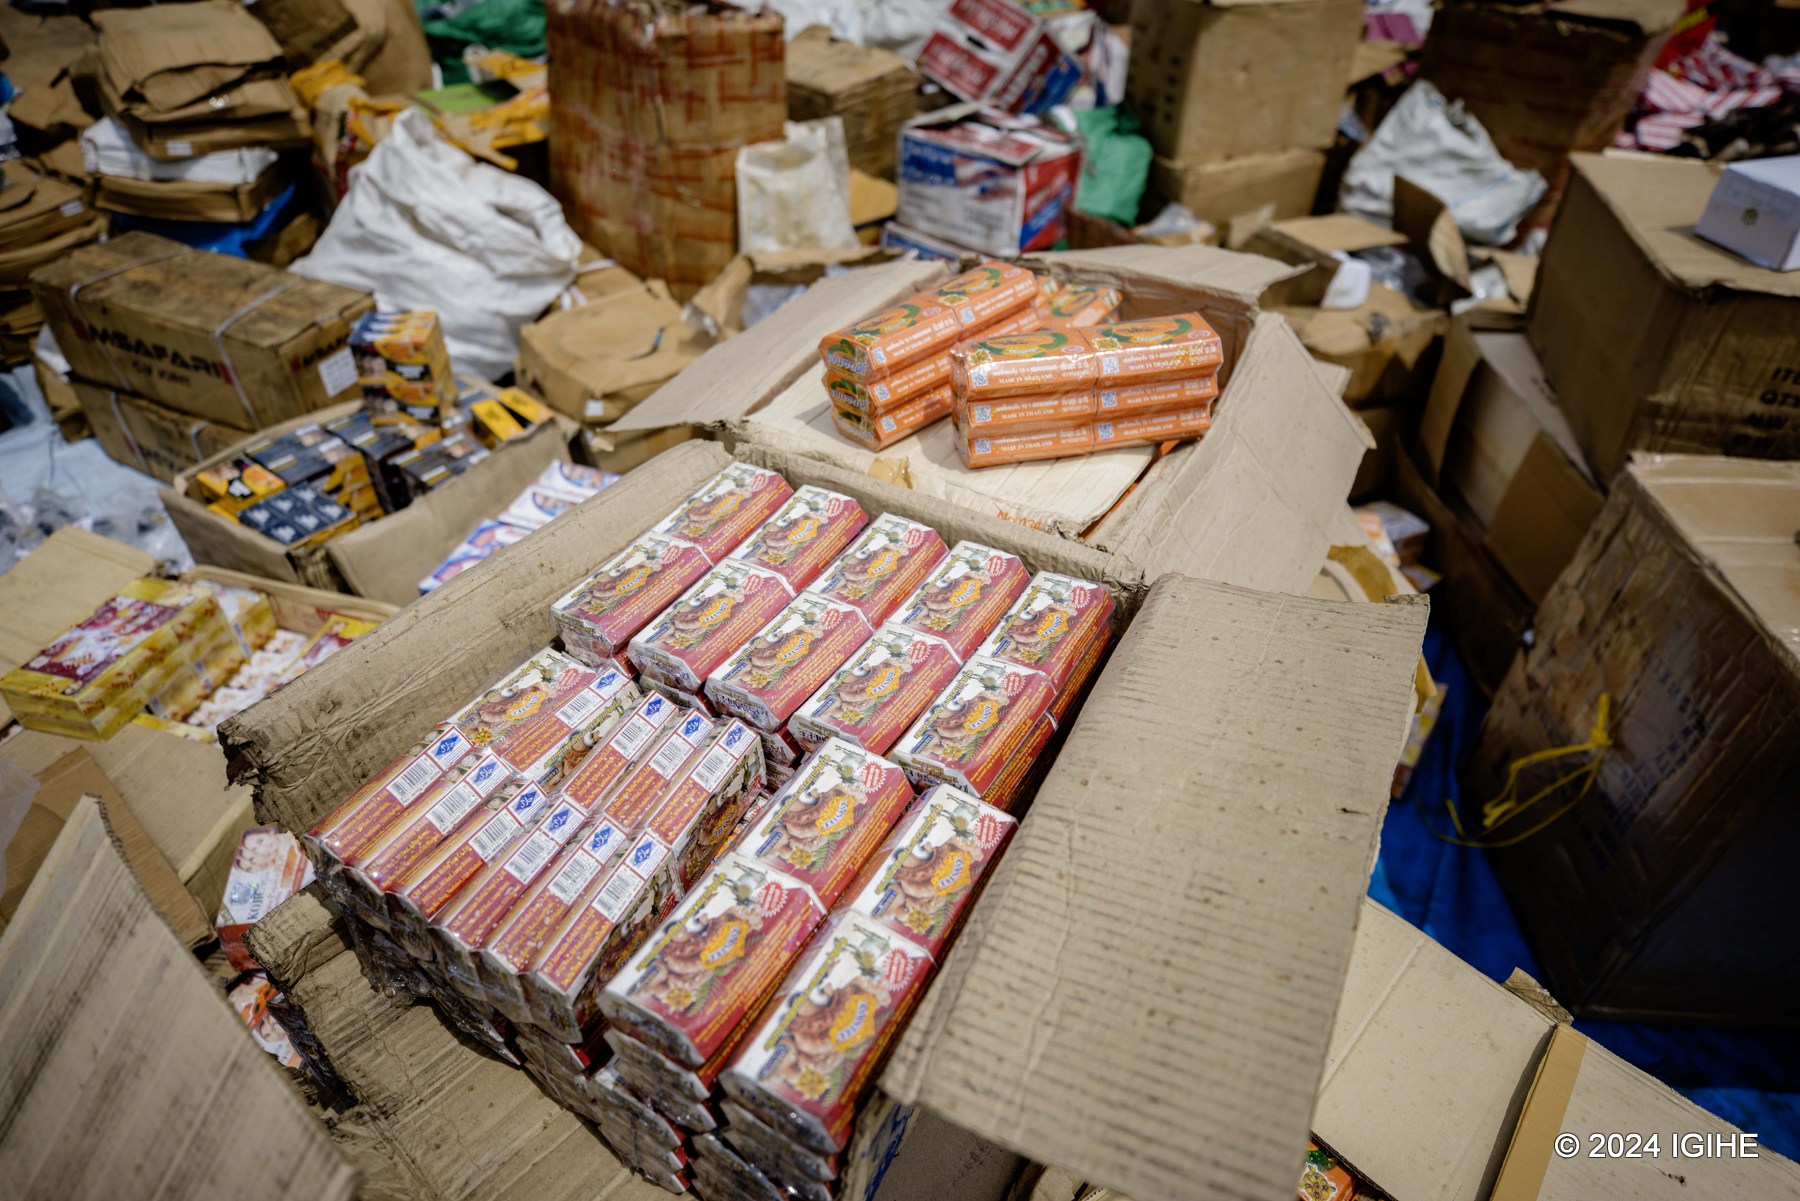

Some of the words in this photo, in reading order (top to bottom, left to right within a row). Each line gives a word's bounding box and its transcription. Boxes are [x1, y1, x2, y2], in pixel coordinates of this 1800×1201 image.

[1153, 359, 1181, 367] THAILAND
[1150, 392, 1177, 400] THAILAND
[1026, 408, 1054, 416] THAILAND
[1146, 423, 1173, 431] THAILAND
[1024, 440, 1052, 448] THAILAND
